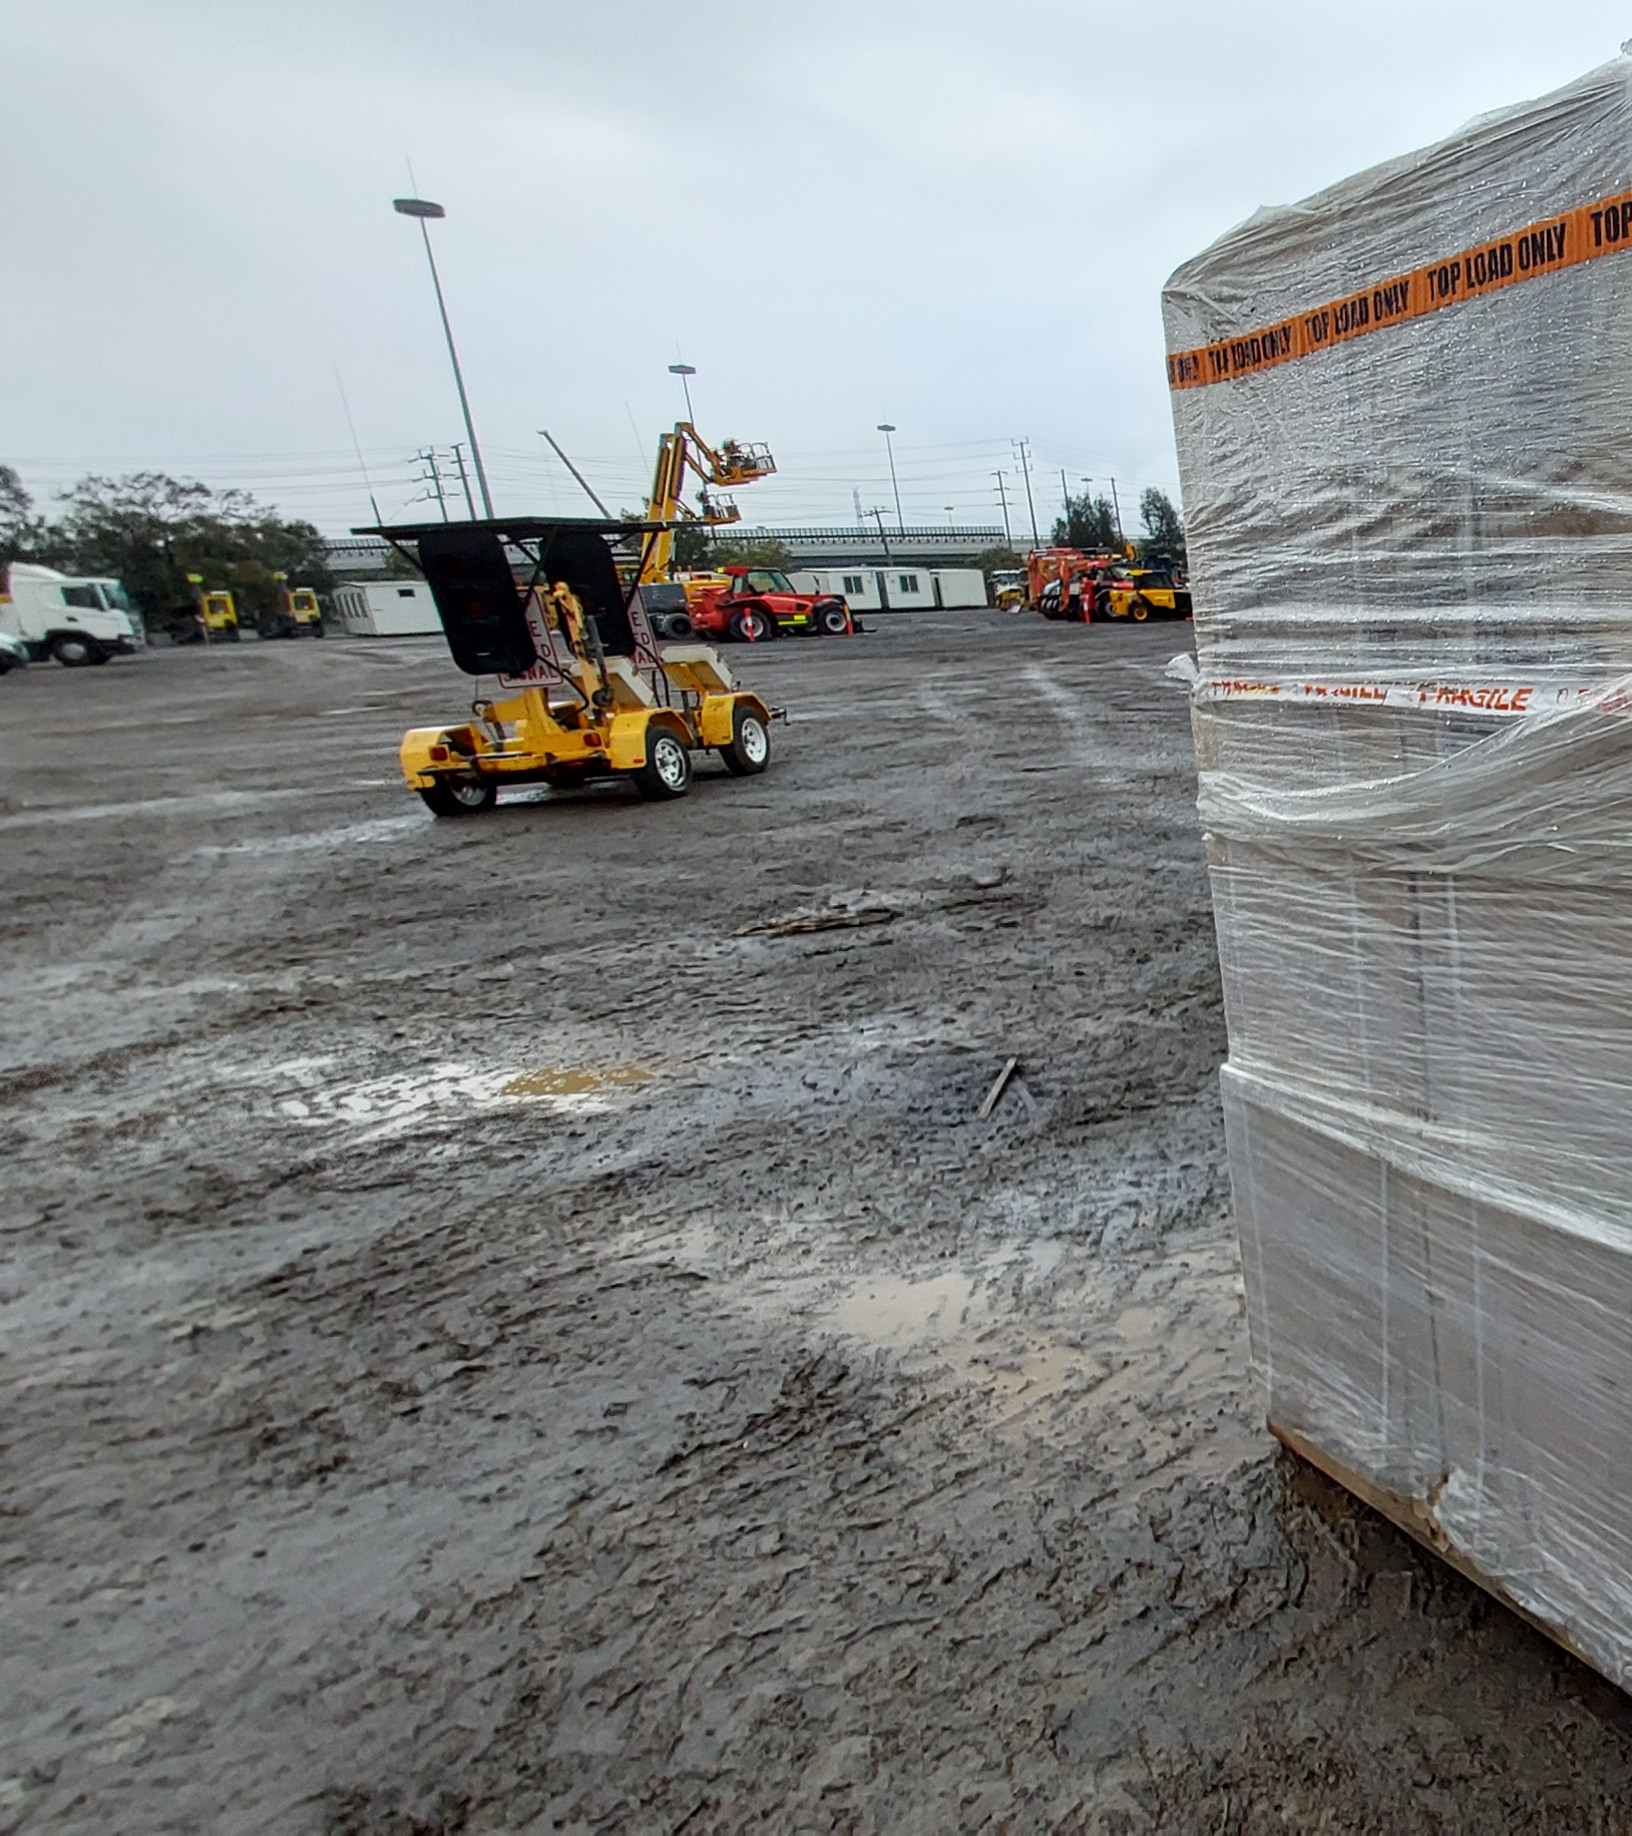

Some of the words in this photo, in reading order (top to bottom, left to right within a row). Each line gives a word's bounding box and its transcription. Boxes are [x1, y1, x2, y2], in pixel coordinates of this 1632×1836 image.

[1427, 261, 1461, 302] TOP
[1465, 243, 1514, 289] LOAD
[1518, 222, 1567, 271] ONLY
[1305, 311, 1329, 345] TOP
[1333, 296, 1369, 335] LOAD
[1373, 280, 1410, 322] ONLY
[1231, 337, 1261, 371] LOAD
[1261, 325, 1292, 361] ONLY
